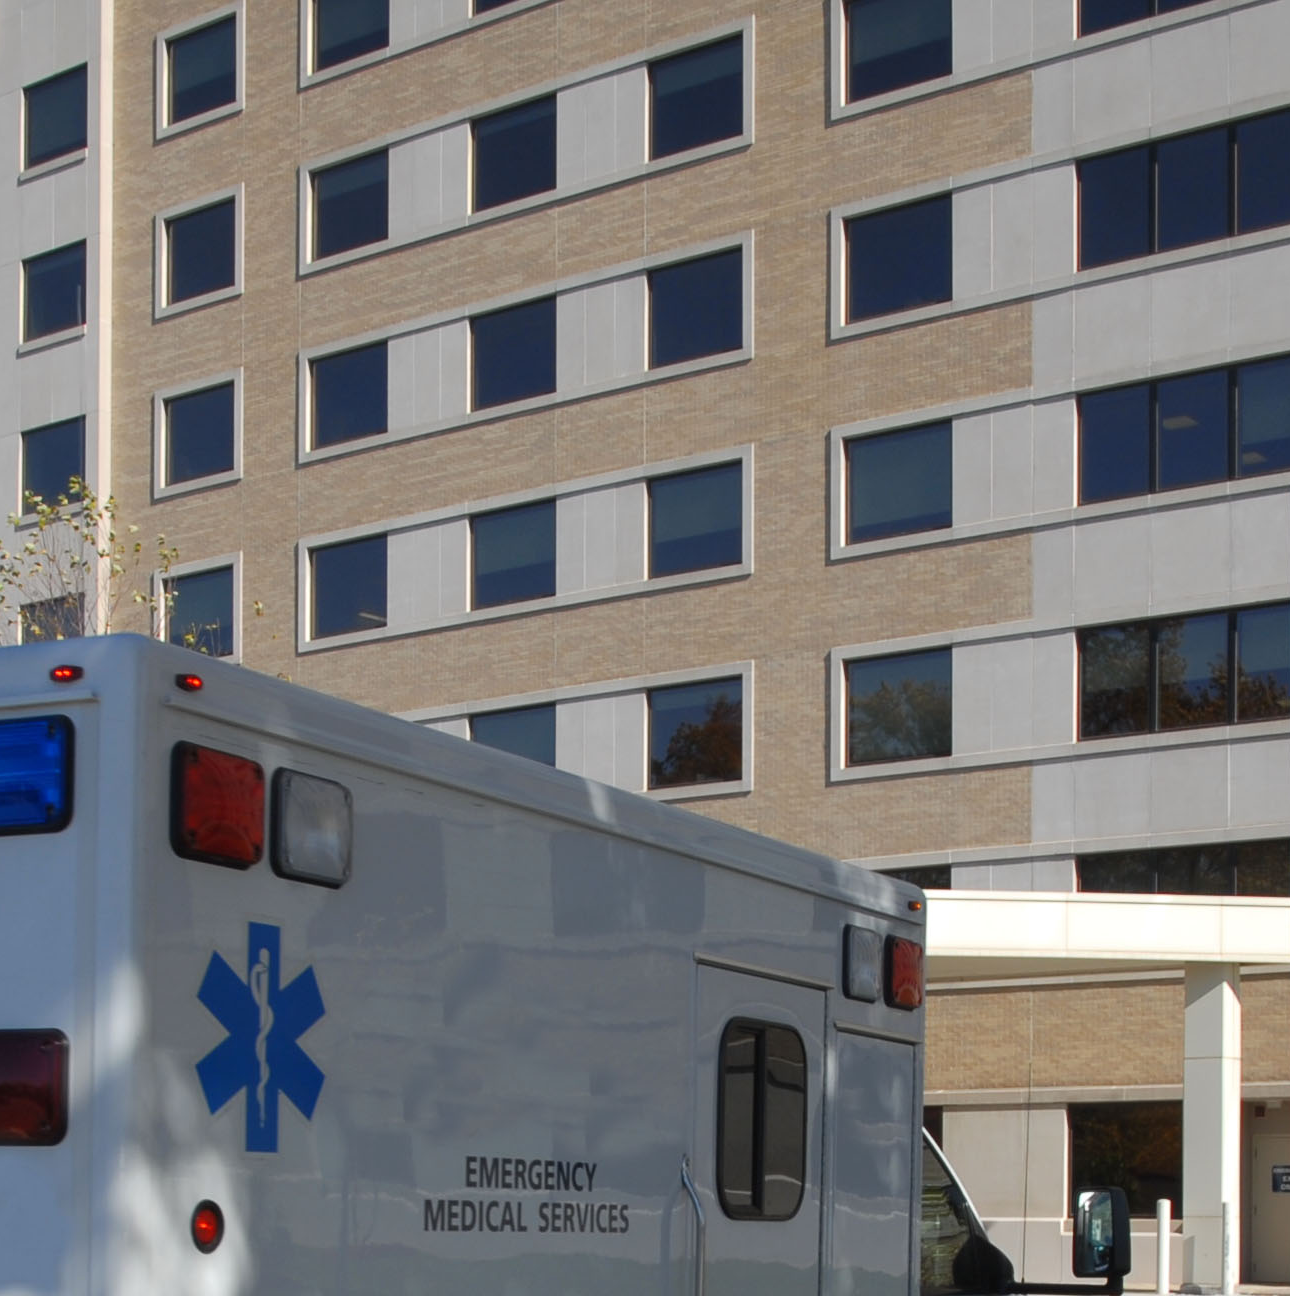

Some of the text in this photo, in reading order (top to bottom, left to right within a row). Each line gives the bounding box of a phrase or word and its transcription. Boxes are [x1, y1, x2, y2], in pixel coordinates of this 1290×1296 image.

[465, 1156, 597, 1191] EMERGENCY
[423, 1200, 630, 1234] MEDICAL SERVICES
